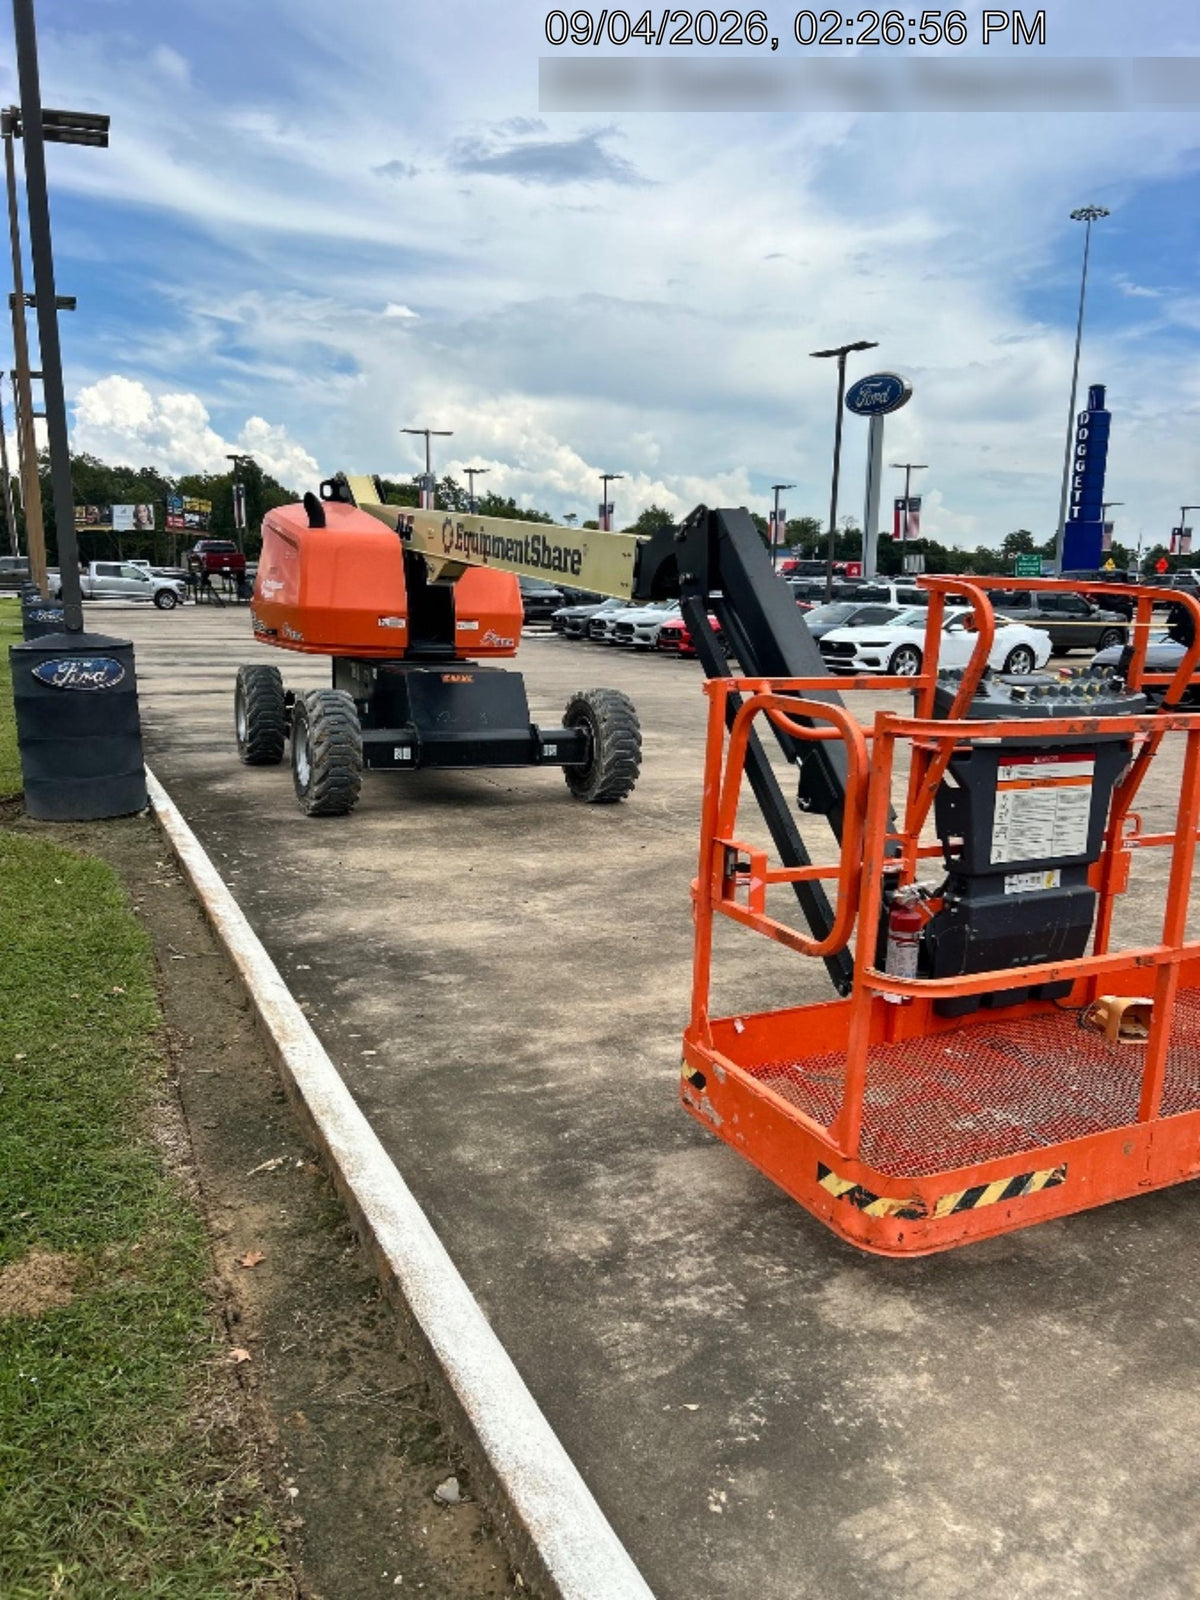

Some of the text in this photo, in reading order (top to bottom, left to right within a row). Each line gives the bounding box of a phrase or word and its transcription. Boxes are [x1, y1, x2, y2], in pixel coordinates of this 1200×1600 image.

[856, 382, 892, 408] Ford
[1072, 412, 1090, 519] DOGGETT
[455, 522, 582, 576] EquipmentShare
[52, 661, 108, 687] Ford
